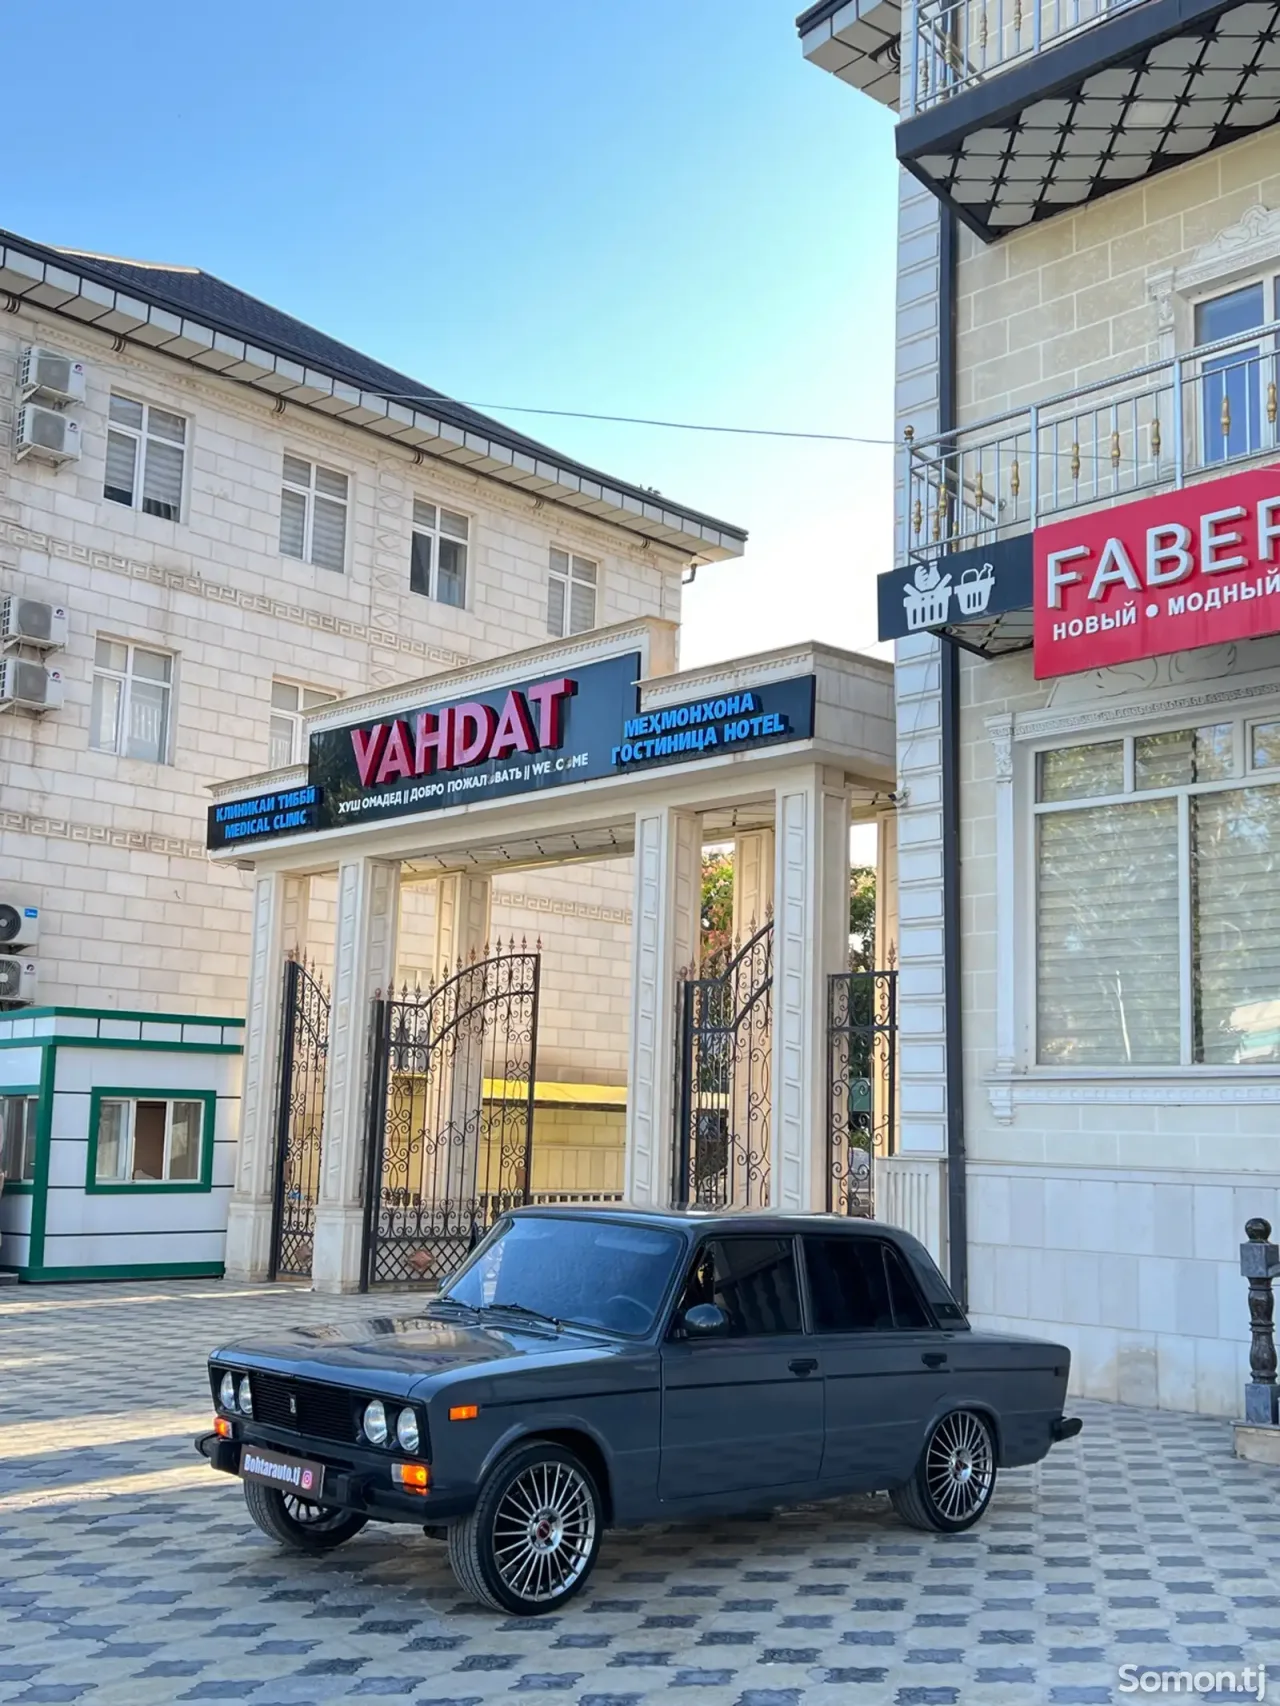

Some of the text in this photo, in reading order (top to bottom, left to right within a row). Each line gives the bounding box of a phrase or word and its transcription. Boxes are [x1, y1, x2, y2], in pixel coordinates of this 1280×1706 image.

[1052, 567, 1280, 641] НОВЫЙ МОДНЫЙ
[350, 678, 578, 789] VAHDAT
[611, 712, 785, 765] ГОСТИНИЦА HOTEL
[337, 798, 361, 814] ХУШ
[361, 790, 402, 809] ОМАДЕД
[409, 783, 445, 802] ДОБРО
[224, 809, 307, 839] MEDICAL CLINIC
[243, 1453, 301, 1486] Bohtarauto.tj
